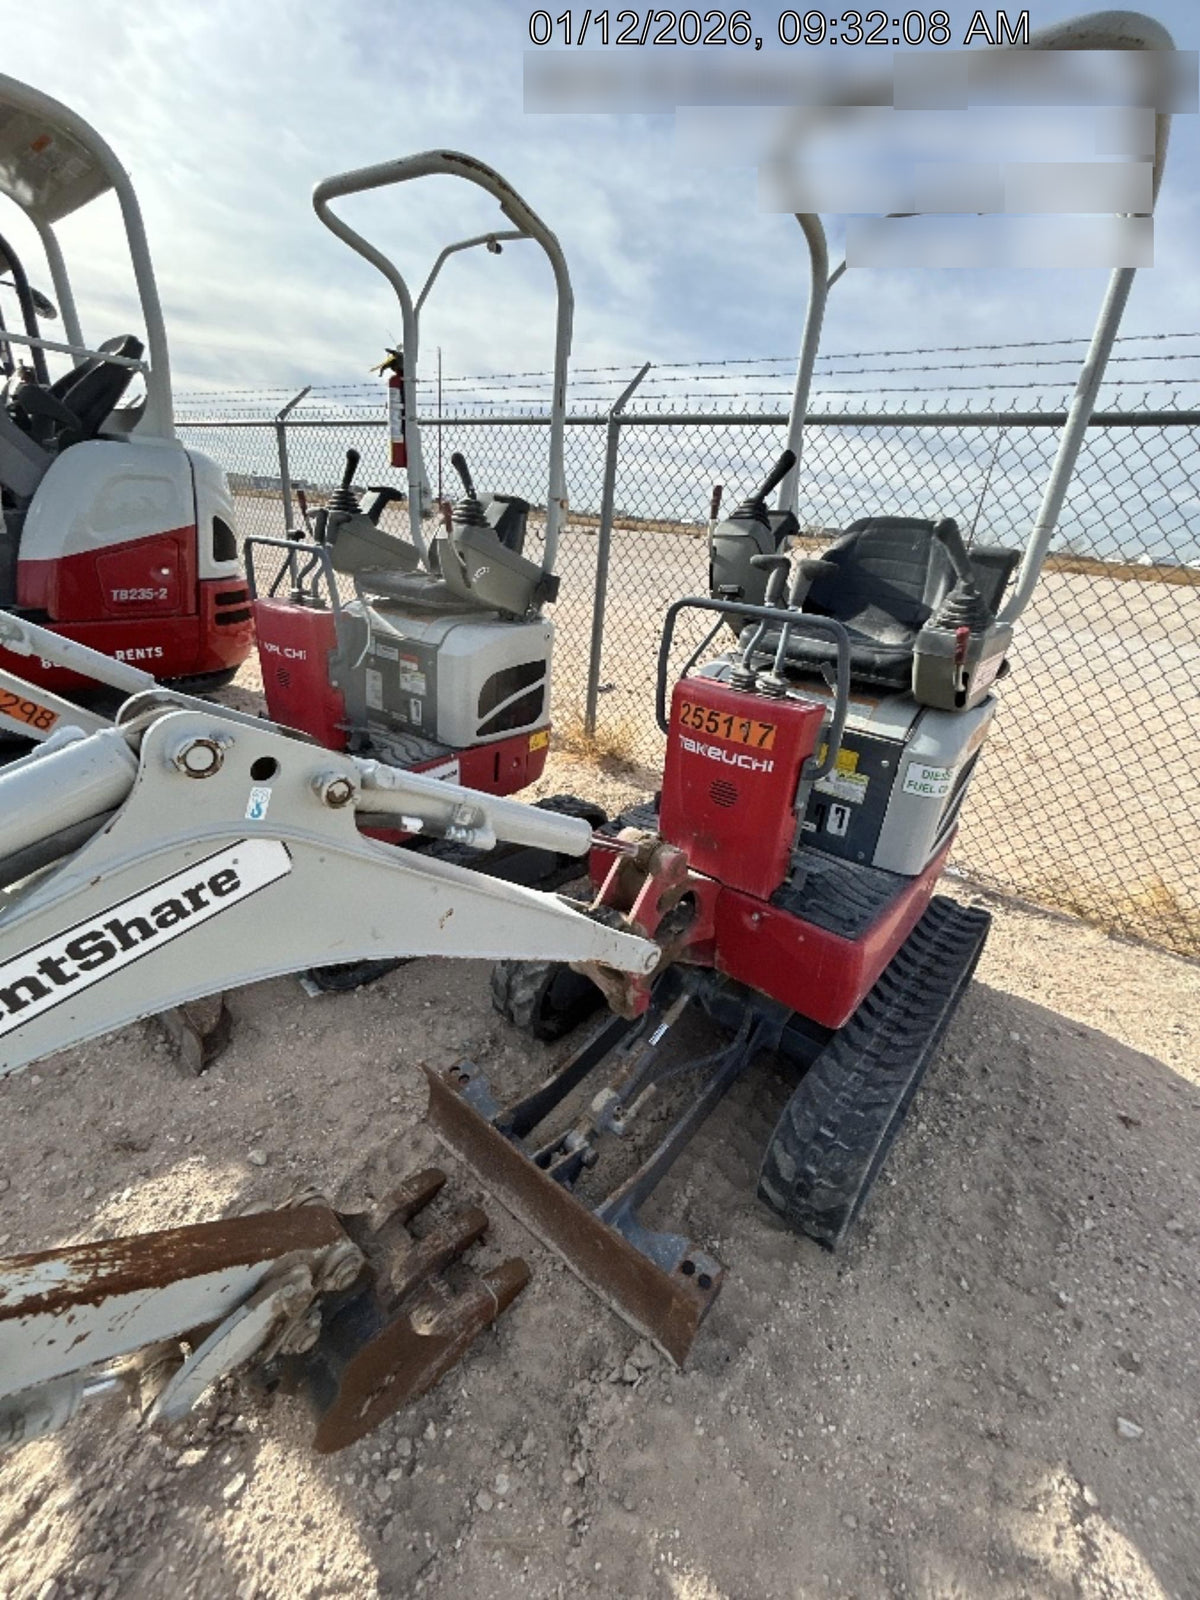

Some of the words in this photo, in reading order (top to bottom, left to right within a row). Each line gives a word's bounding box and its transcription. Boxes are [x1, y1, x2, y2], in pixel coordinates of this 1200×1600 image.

[111, 587, 168, 601] TB235-2
[680, 702, 774, 747] 255117
[921, 768, 952, 782] DIES
[906, 779, 936, 794] FUEL
